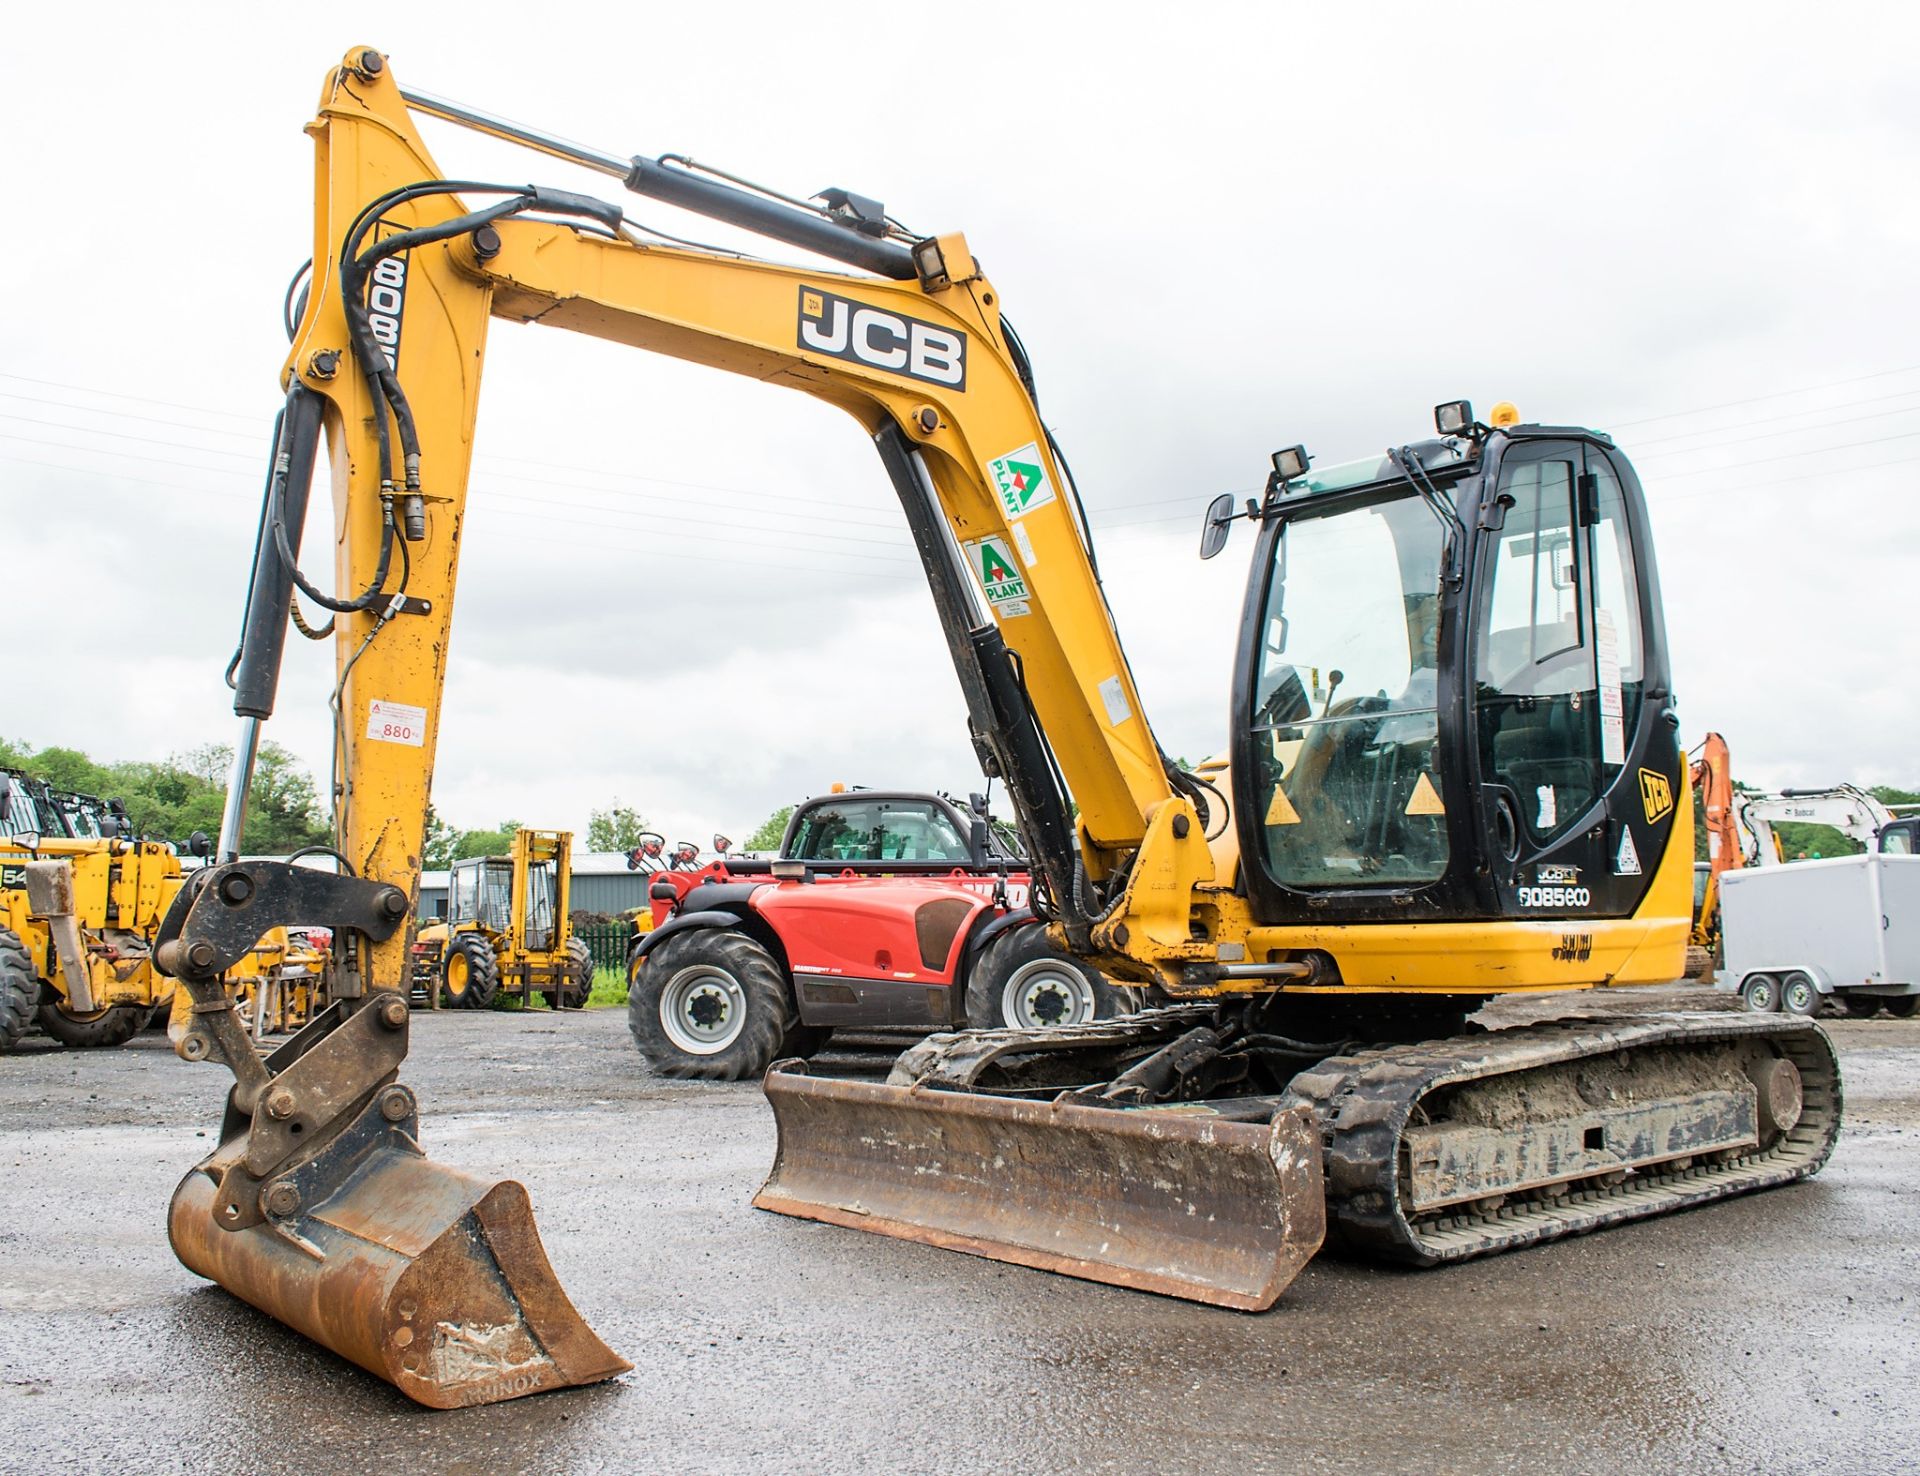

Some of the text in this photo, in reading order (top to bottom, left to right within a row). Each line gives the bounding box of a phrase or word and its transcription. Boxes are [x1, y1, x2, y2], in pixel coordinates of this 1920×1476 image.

[802, 300, 962, 385] JCB
[991, 459, 1020, 514] PLANT
[986, 581, 1026, 601] PLANT
[383, 723, 411, 740] 880
[1643, 774, 1670, 818] JCB
